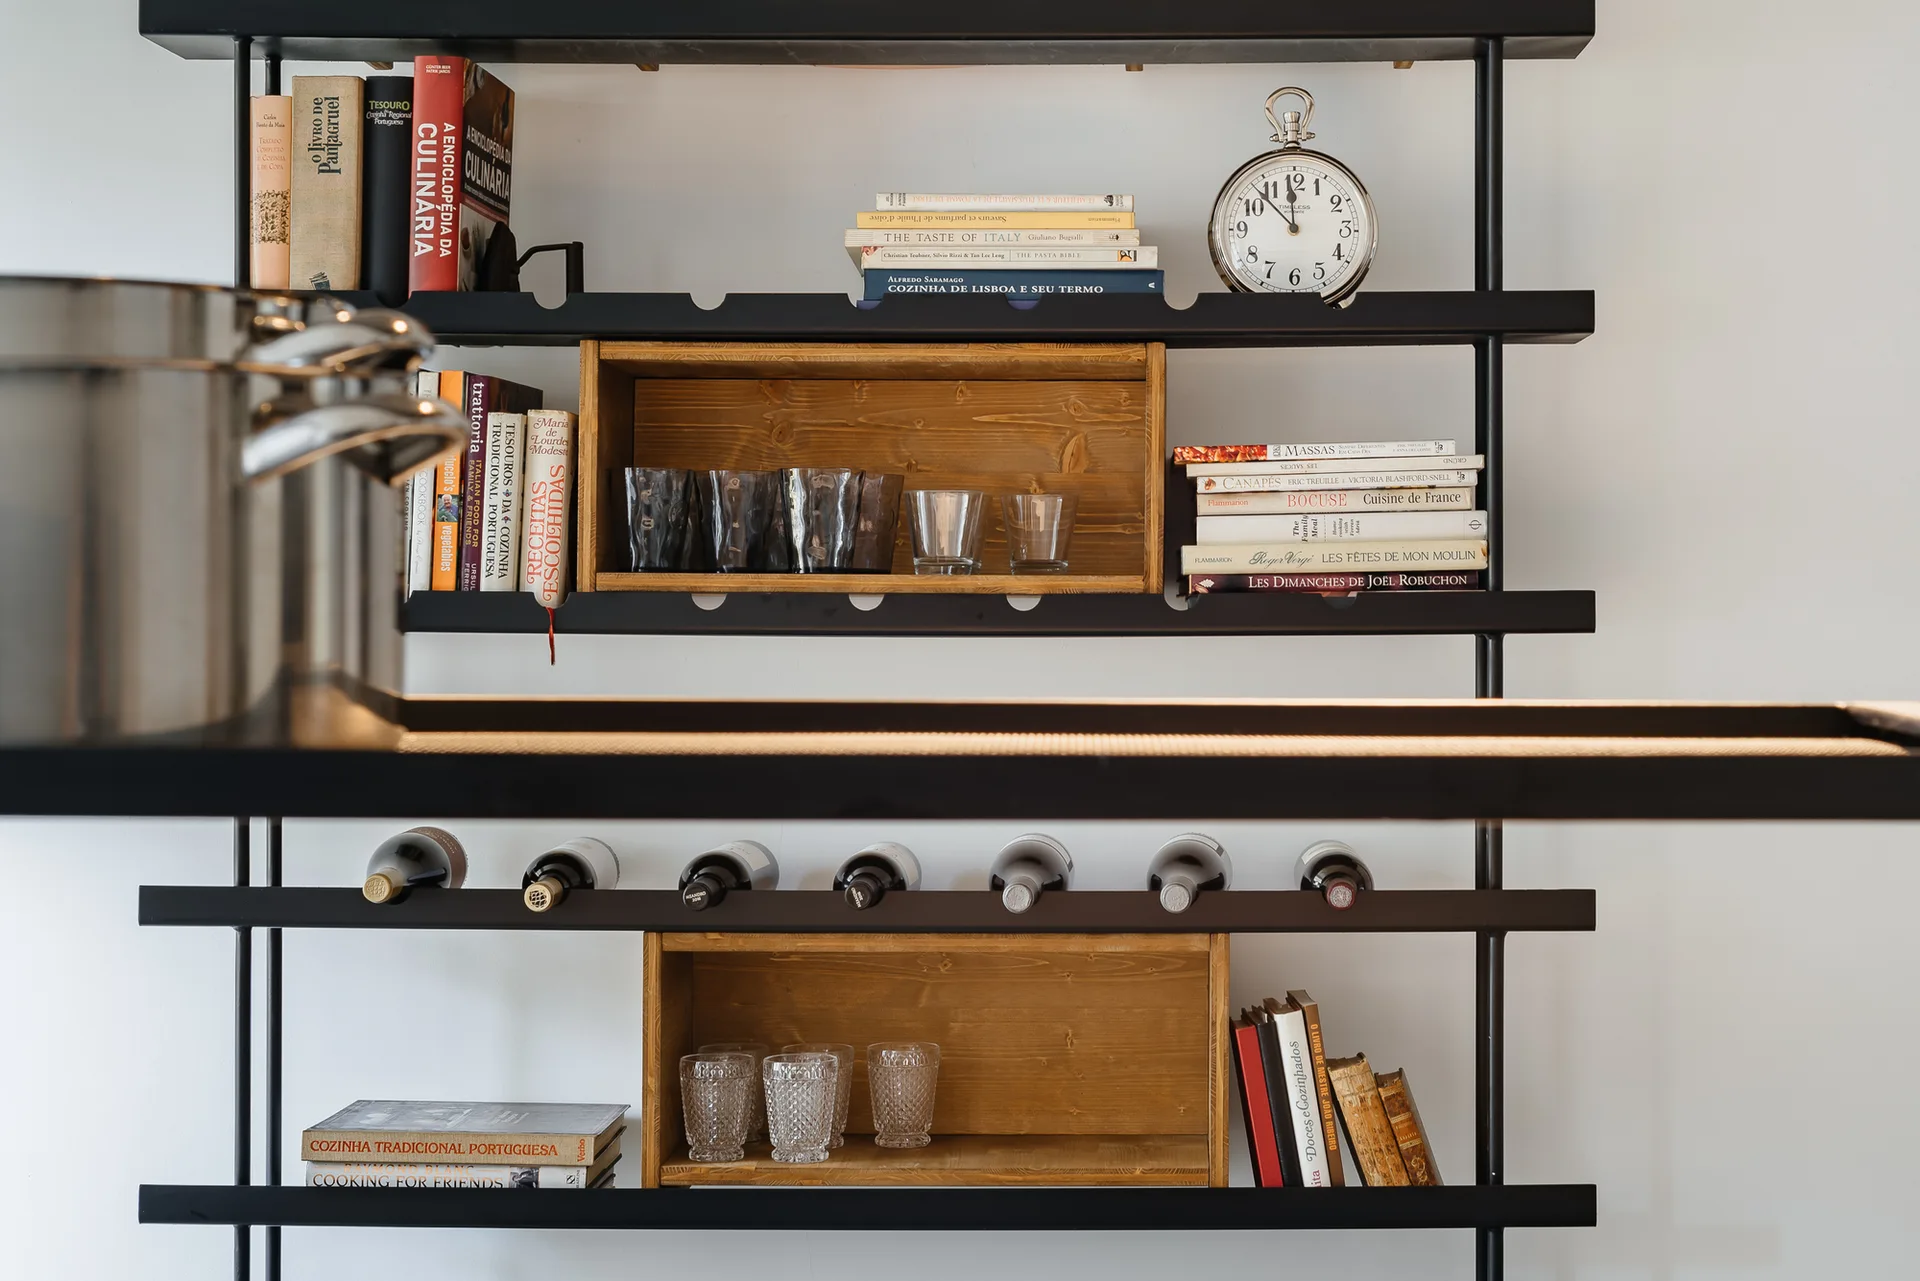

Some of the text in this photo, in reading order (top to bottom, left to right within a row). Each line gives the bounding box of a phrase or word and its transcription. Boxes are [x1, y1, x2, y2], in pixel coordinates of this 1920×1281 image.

[369, 101, 410, 110] TESOURO
[374, 118, 403, 126] Portuguesa
[388, 111, 412, 119] Regional
[466, 125, 471, 140] A
[471, 127, 505, 161] ENCICLOPÉDIA
[465, 150, 510, 201] CULINÁRIA
[1285, 173, 1305, 191] 12
[414, 123, 440, 257] CULINÁRIA
[440, 122, 456, 257] A ENCICLOPÉDIA DA
[1263, 181, 1278, 198] 11
[1313, 178, 1320, 196] 1
[1244, 198, 1264, 216] 10
[1330, 195, 1342, 213] 2
[935, 214, 966, 222] parfums
[884, 233, 910, 242] THE
[917, 233, 954, 242] TASTE
[962, 233, 977, 242] OF
[984, 233, 1021, 242] ITALY
[1236, 221, 1248, 238] 9
[1339, 220, 1352, 238] 3
[1246, 245, 1258, 264] 8
[1332, 243, 1345, 260] 4
[1265, 261, 1276, 278] 7
[1289, 268, 1301, 286] 6
[1313, 262, 1325, 280] 5
[470, 382, 484, 453] trattoria
[533, 417, 568, 429] Maria
[546, 427, 557, 436] de
[1285, 445, 1335, 456] MASSAS
[1223, 476, 1281, 490] CANAPÉS
[417, 471, 427, 525] COOKBOOK
[485, 422, 502, 579] TRADICIONAL PORTUGUESA
[498, 423, 515, 579] TESOUROS DA COZINHA
[1287, 493, 1347, 507] BOCUSE
[1364, 493, 1404, 504] Cuisine
[1408, 492, 1420, 504] de
[1425, 492, 1461, 503] France
[527, 480, 547, 584] RECEITAS
[542, 464, 566, 602] ESCOLHIDAS
[440, 525, 453, 572] vegetables
[1249, 551, 1283, 569] Roger
[1322, 553, 1342, 563] LES
[1347, 551, 1381, 562] FÊTES
[1384, 552, 1399, 561] DE
[1402, 551, 1429, 561] MON
[1433, 550, 1476, 560] MOULIN
[1249, 574, 1468, 589] LES DIMANCHES DE JOËL ROBUCHON
[1311, 1031, 1322, 1053] LIVRO
[1316, 1055, 1324, 1065] DE
[1290, 1040, 1308, 1111] Cozinhados
[1318, 1066, 1328, 1097] MESTRE
[1307, 1118, 1317, 1162] Doces
[1326, 1121, 1337, 1150] RIBEIRO
[310, 1140, 558, 1156] COZINHA TRADICIONAL PORTUGUESA
[577, 1138, 585, 1162] Verbo
[344, 1163, 474, 1176] RAYMOND BLANC
[313, 1174, 503, 1188] COOKING FOR FRIENDS
